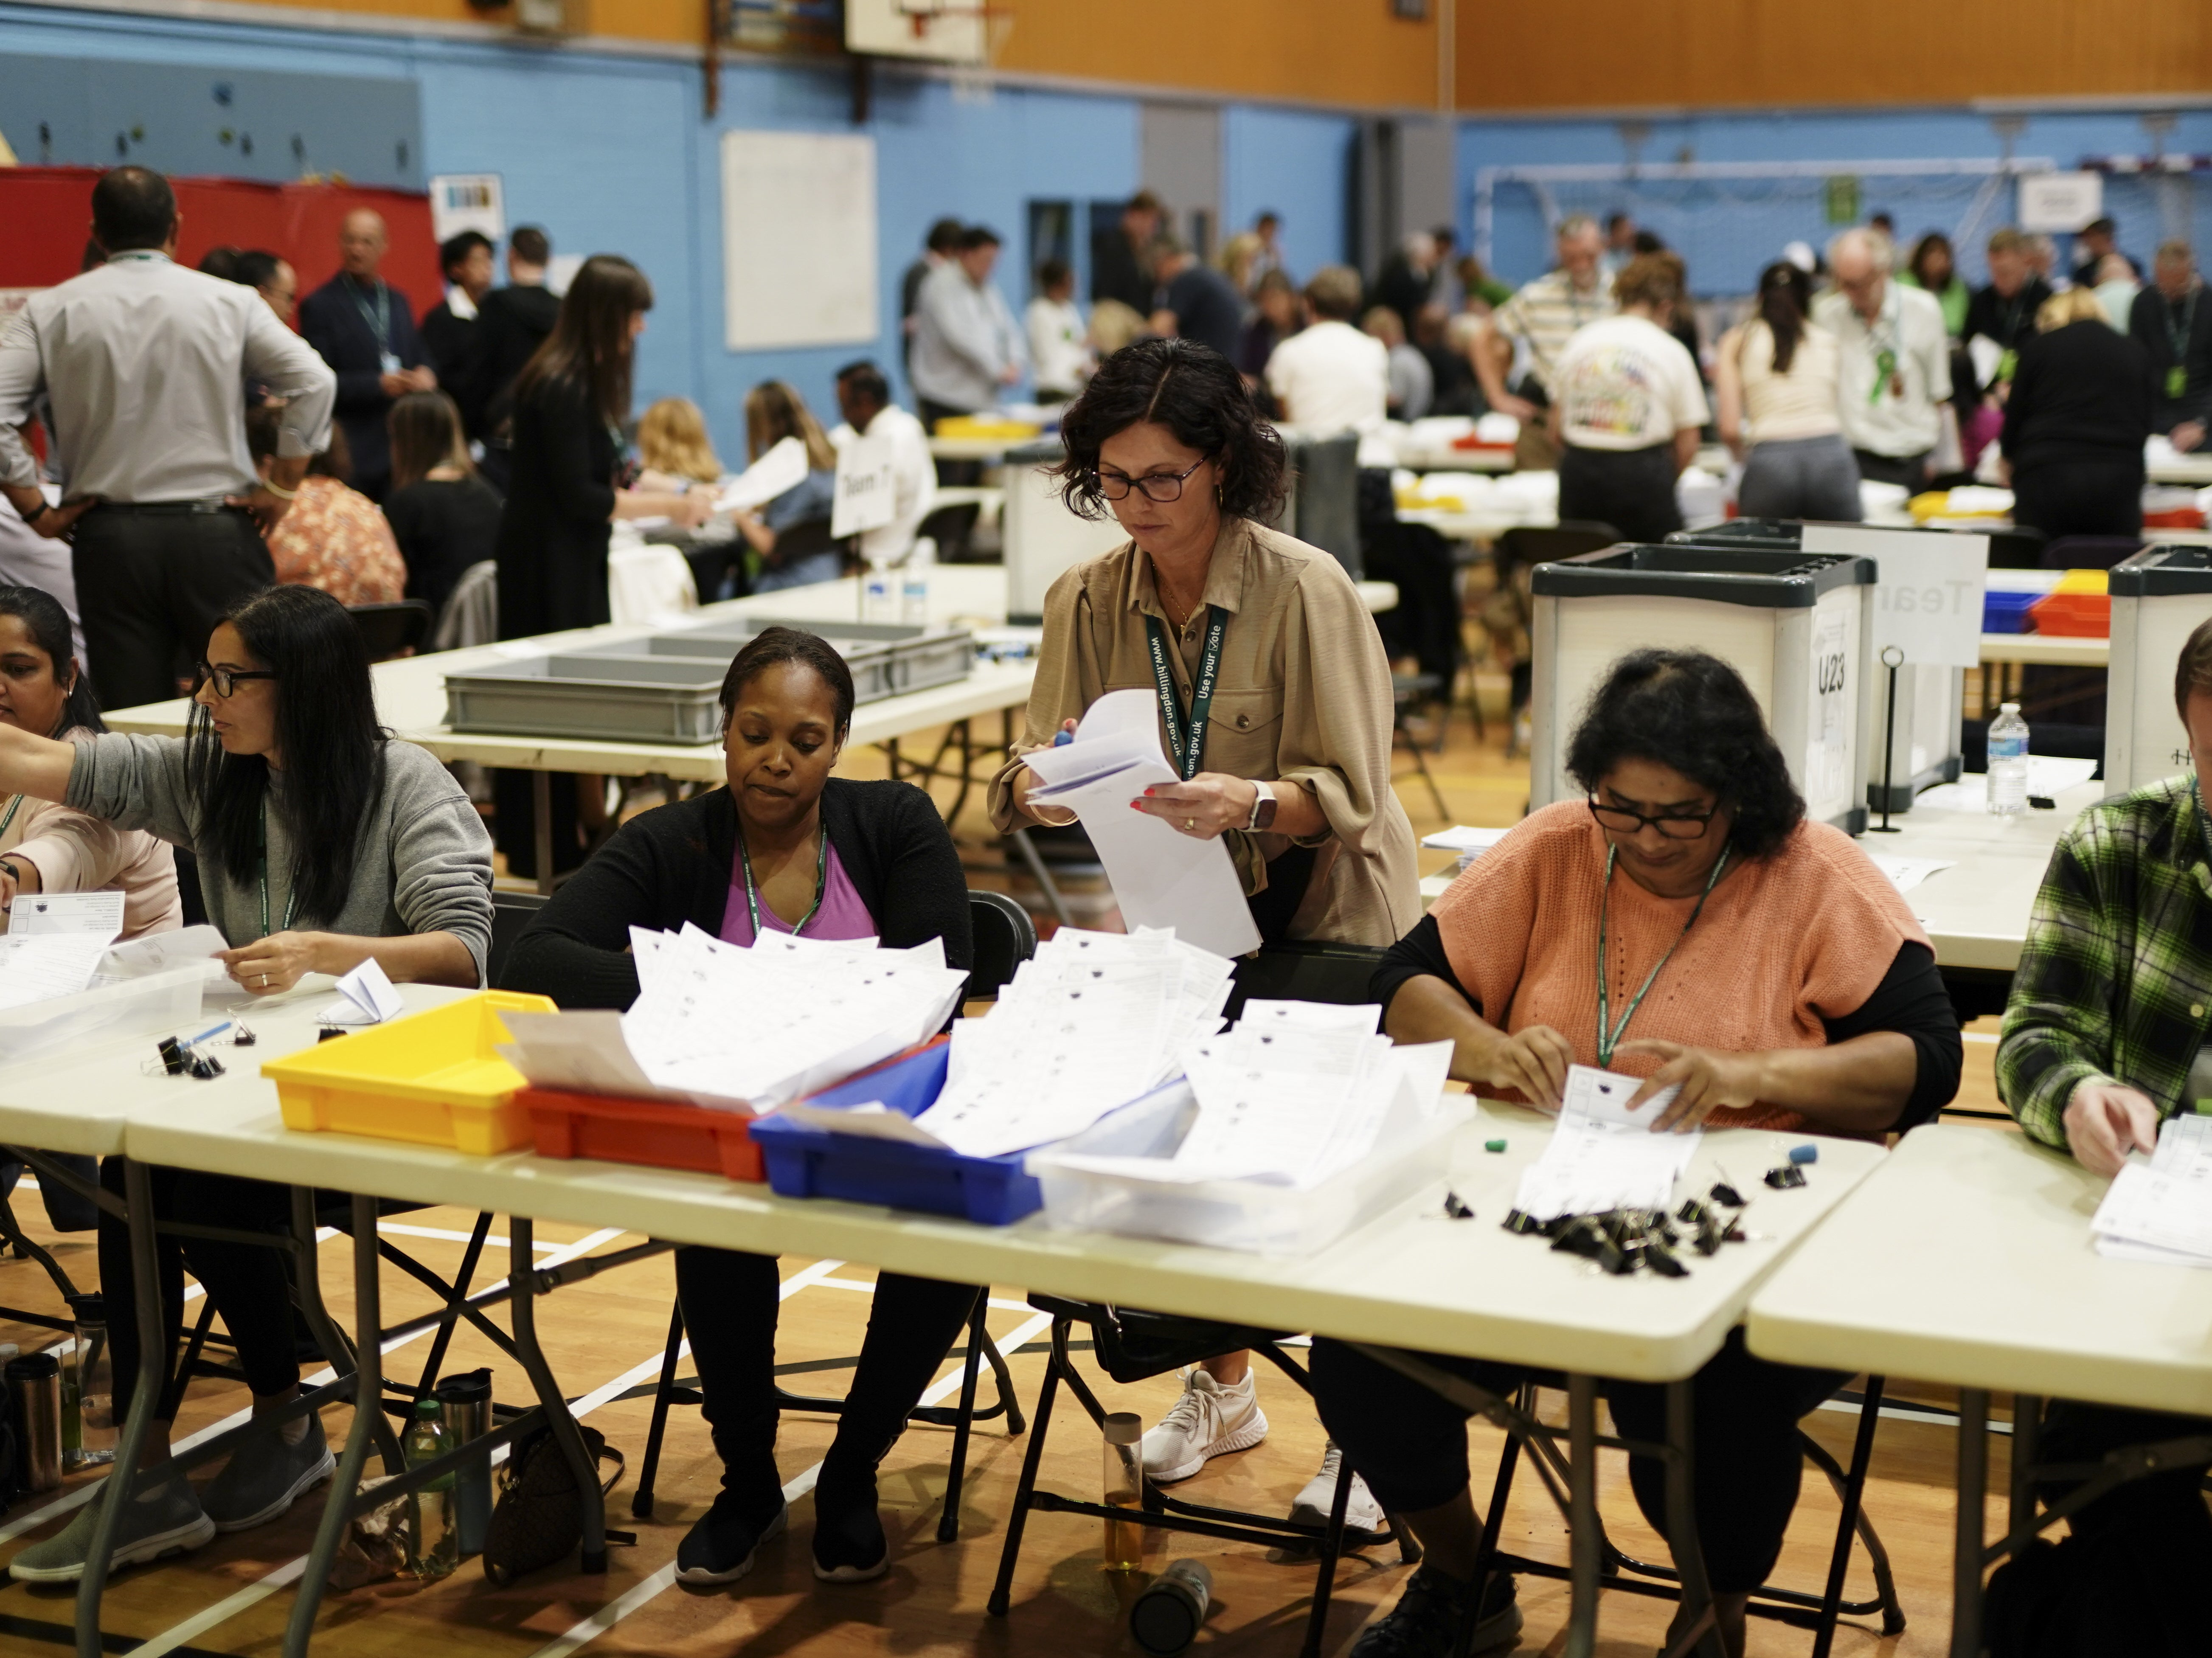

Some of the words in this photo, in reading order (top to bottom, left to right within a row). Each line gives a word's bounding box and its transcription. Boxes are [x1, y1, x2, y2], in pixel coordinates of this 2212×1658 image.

[1204, 652, 1215, 677] your
[1819, 653, 1845, 696] U23
[1151, 637, 1181, 756] www.hillingdon.gov.uk
[1198, 678, 1211, 699] Use
[1188, 721, 1203, 780] don.gov.uk
[745, 863, 756, 907] www.hillingdon.gov.uk
